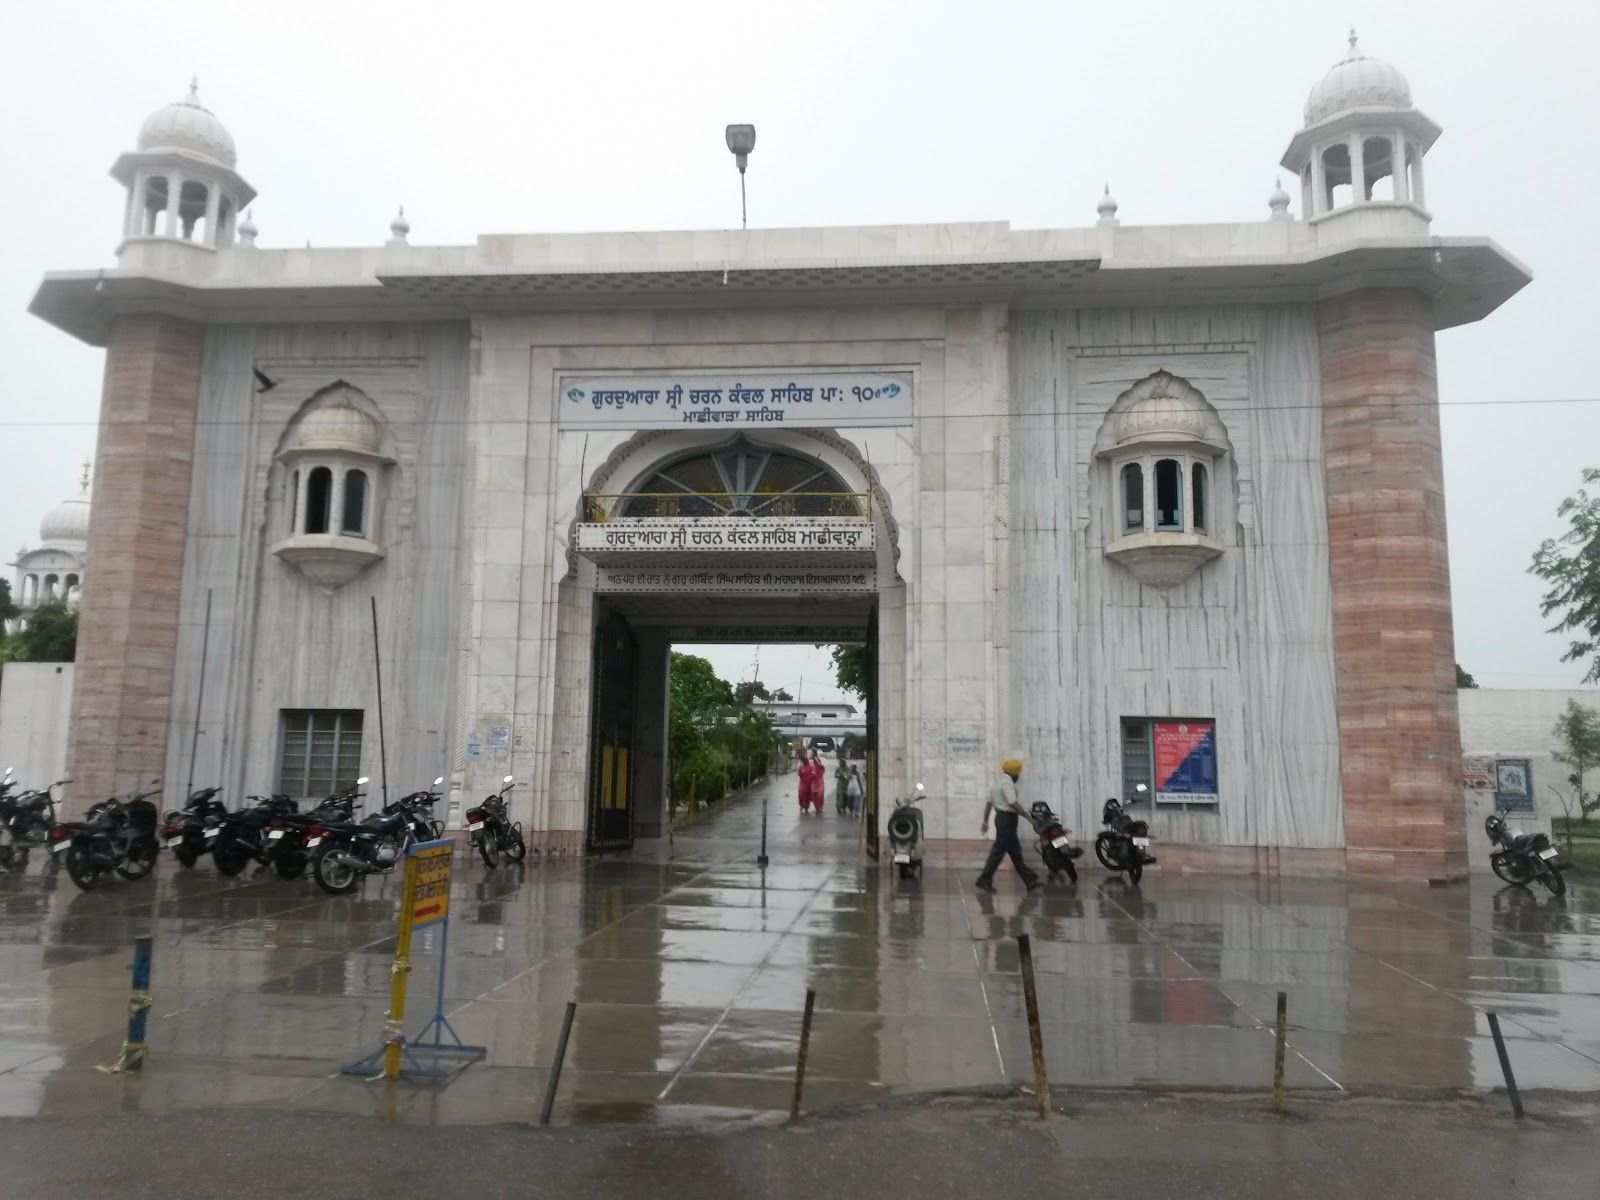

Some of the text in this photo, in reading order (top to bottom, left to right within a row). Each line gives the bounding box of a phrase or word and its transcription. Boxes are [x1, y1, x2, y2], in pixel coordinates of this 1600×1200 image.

[592, 389, 660, 409] ਗੁਰਦੁਆਰਾ
[666, 384, 683, 409] ਸ੍ਰੀ
[689, 389, 723, 404] ਚਰਨ
[728, 383, 764, 404] ਕੰਵਲ
[771, 383, 814, 403] ਸਾਹਿਬ
[820, 387, 843, 402] ਪਾ:
[683, 406, 784, 423] ਮਾਛੀਵਾੜਾ ਸਾਹਿਬ
[606, 528, 862, 549] ਗੁਰਦੁਆਰਾ ਸ੍ਰੀ ਚਰਨ ਕੰਵਲ ਸਾਹਿਬ ਮਾਛੀਵਾੜਾ
[735, 572, 760, 584] ਸਾਹਿਬ
[763, 573, 772, 584] ਜੀ
[774, 575, 805, 584] ਮਹਾਰਾਜ
